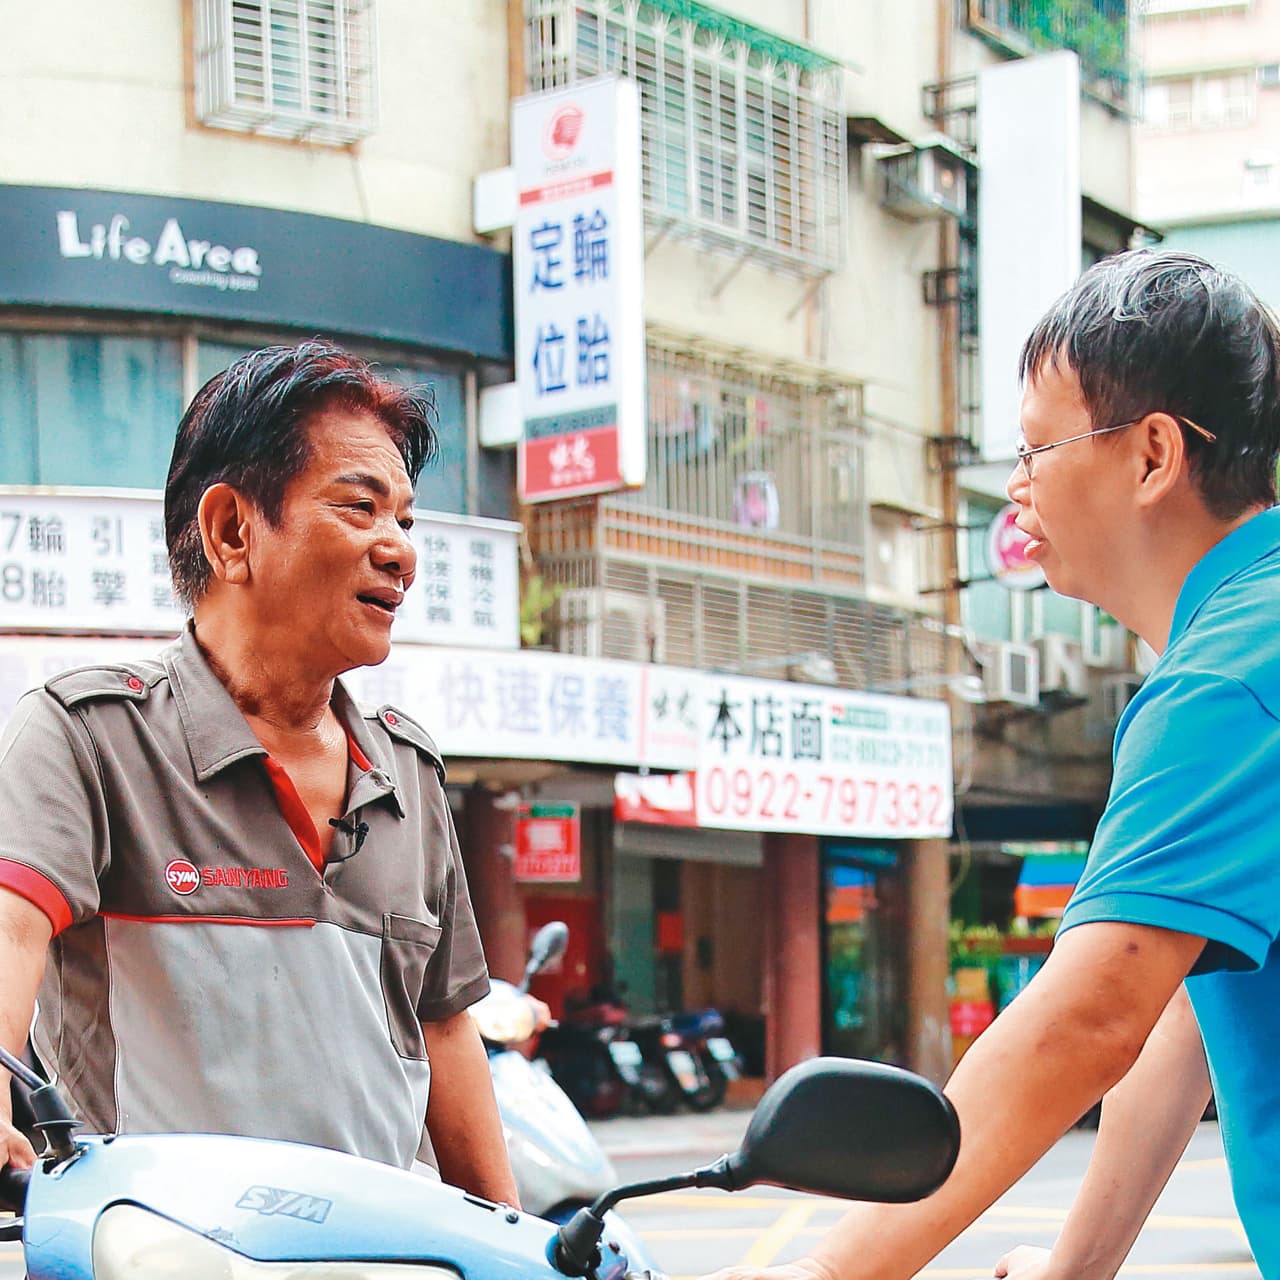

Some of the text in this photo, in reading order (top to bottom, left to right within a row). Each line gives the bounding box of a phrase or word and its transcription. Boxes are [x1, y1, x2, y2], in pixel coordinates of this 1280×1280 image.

[529, 220, 568, 395] 定位
[573, 208, 610, 389] 輪胎
[439, 661, 629, 743] 快速保養
[707, 689, 822, 761] 本店面
[707, 767, 946, 828] 0922-797332
[168, 867, 289, 888] SYM SANYANG
[240, 1187, 332, 1223] SYM
